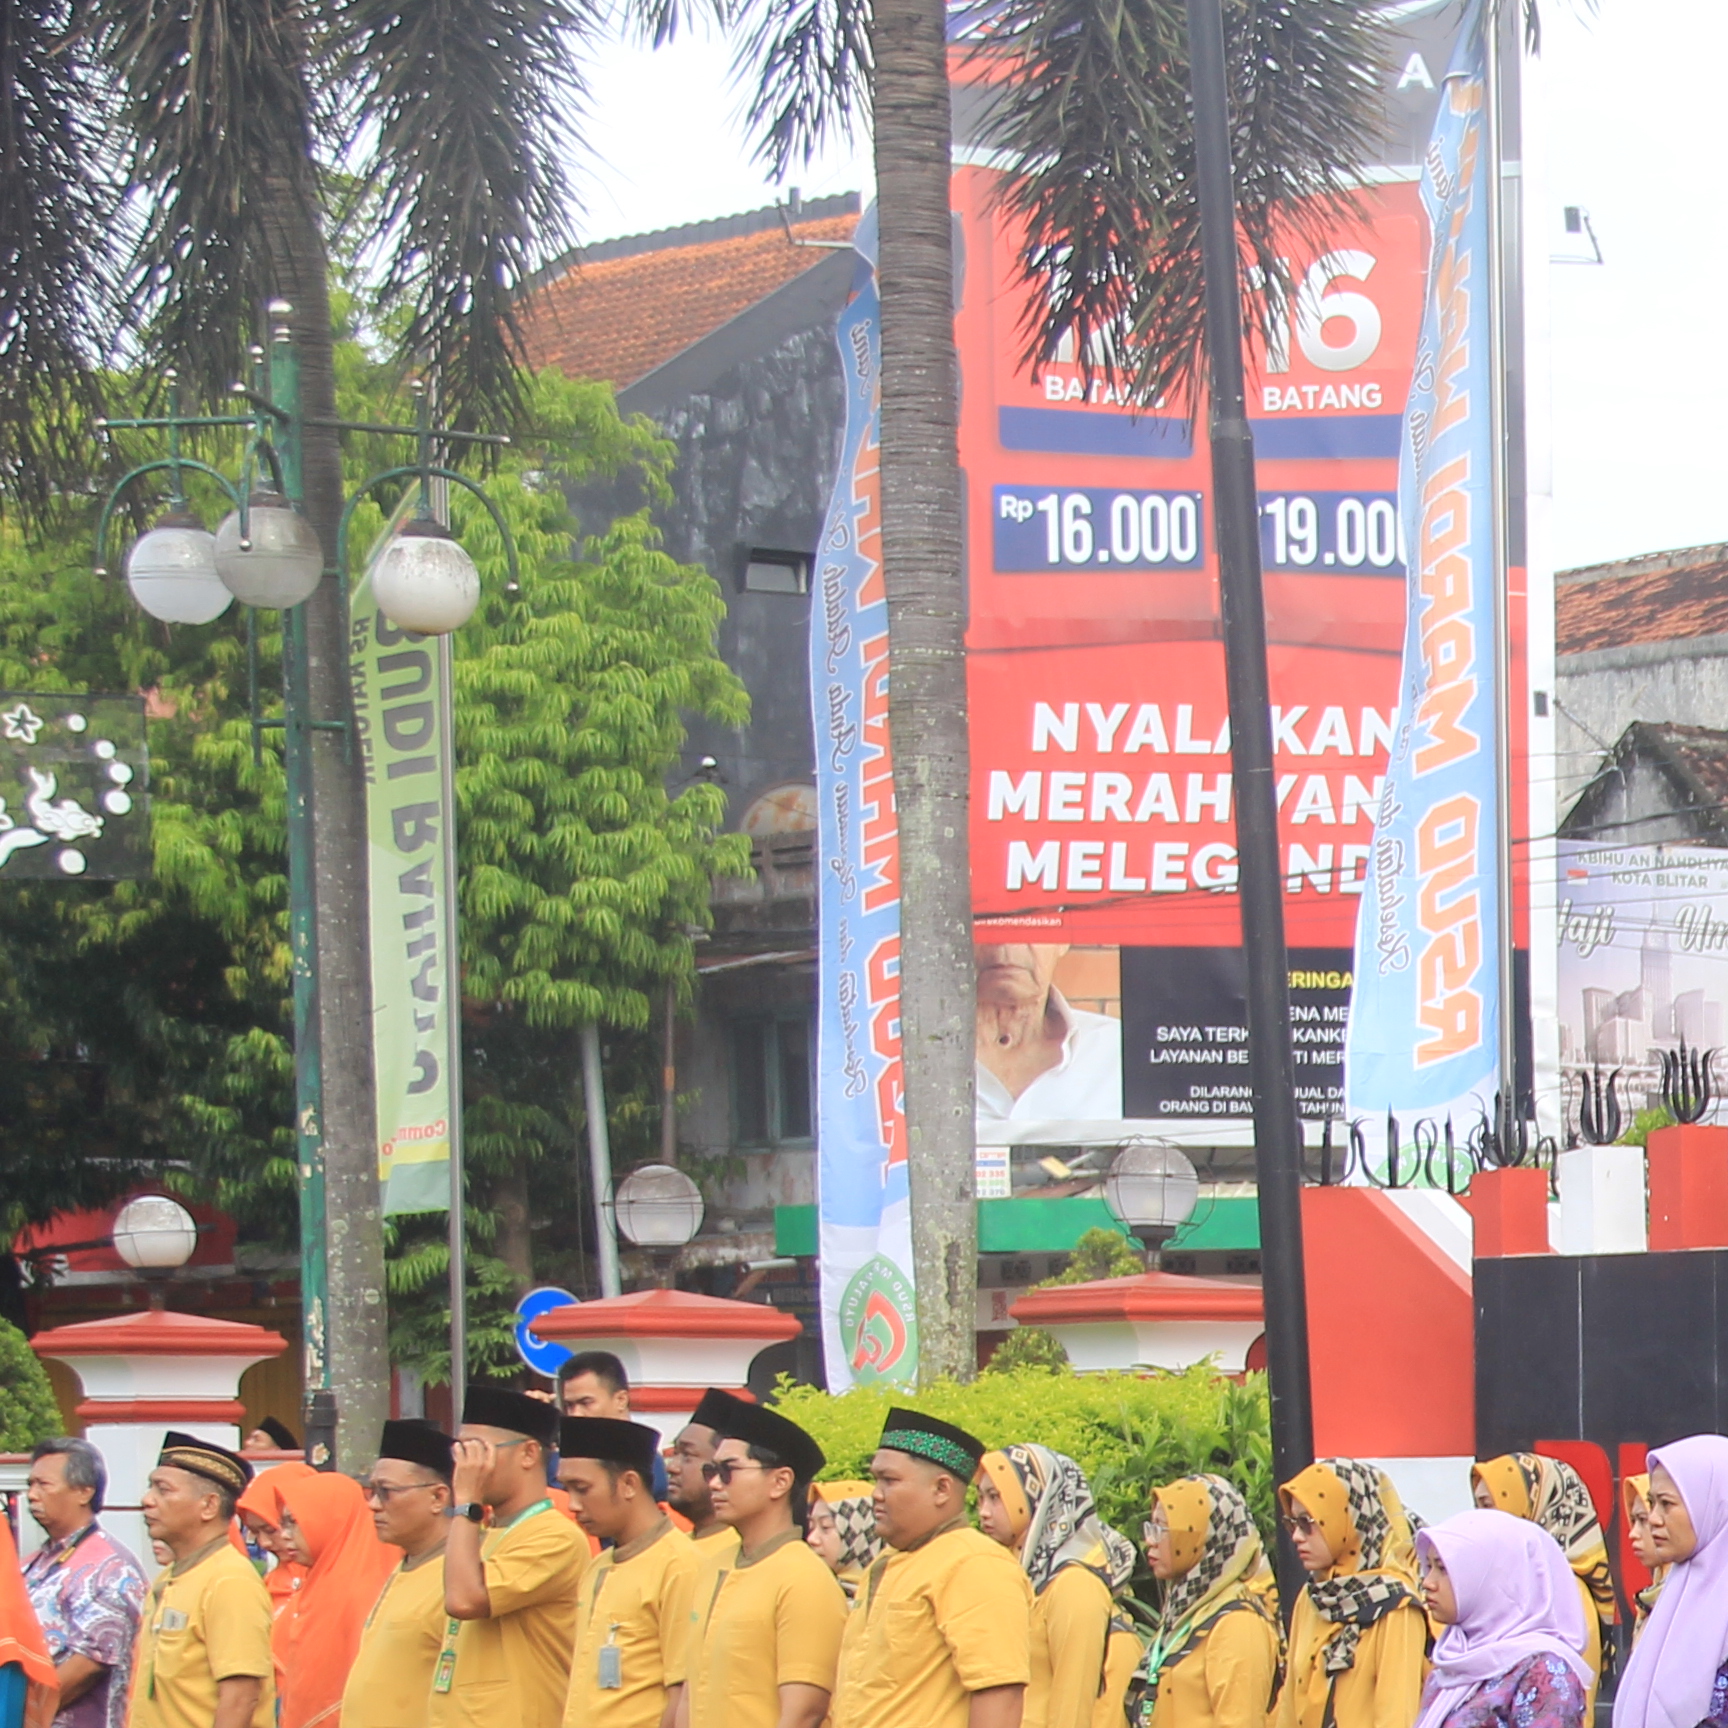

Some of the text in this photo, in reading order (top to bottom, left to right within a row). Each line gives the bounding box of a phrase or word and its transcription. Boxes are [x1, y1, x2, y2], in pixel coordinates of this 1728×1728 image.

[1248, 248, 1383, 373] 16
[1263, 383, 1383, 412] BATANG
[1001, 495, 1033, 523] Rp
[986, 770, 1385, 825] MERAH AN
[1577, 850, 1624, 865] KBIHU
[1628, 853, 1651, 867] AN
[1006, 841, 1373, 894] MELEGND
[1611, 871, 1652, 885] KOTA
[1656, 874, 1709, 888] BLITAR
[1156, 1026, 1346, 1043] SAYA TERK KANK
[1150, 1048, 1223, 1064] LAYANAN
[1190, 1085, 1253, 1099] DILARAN
[1159, 1100, 1210, 1113] ORANG
[1212, 1101, 1227, 1113] DI
